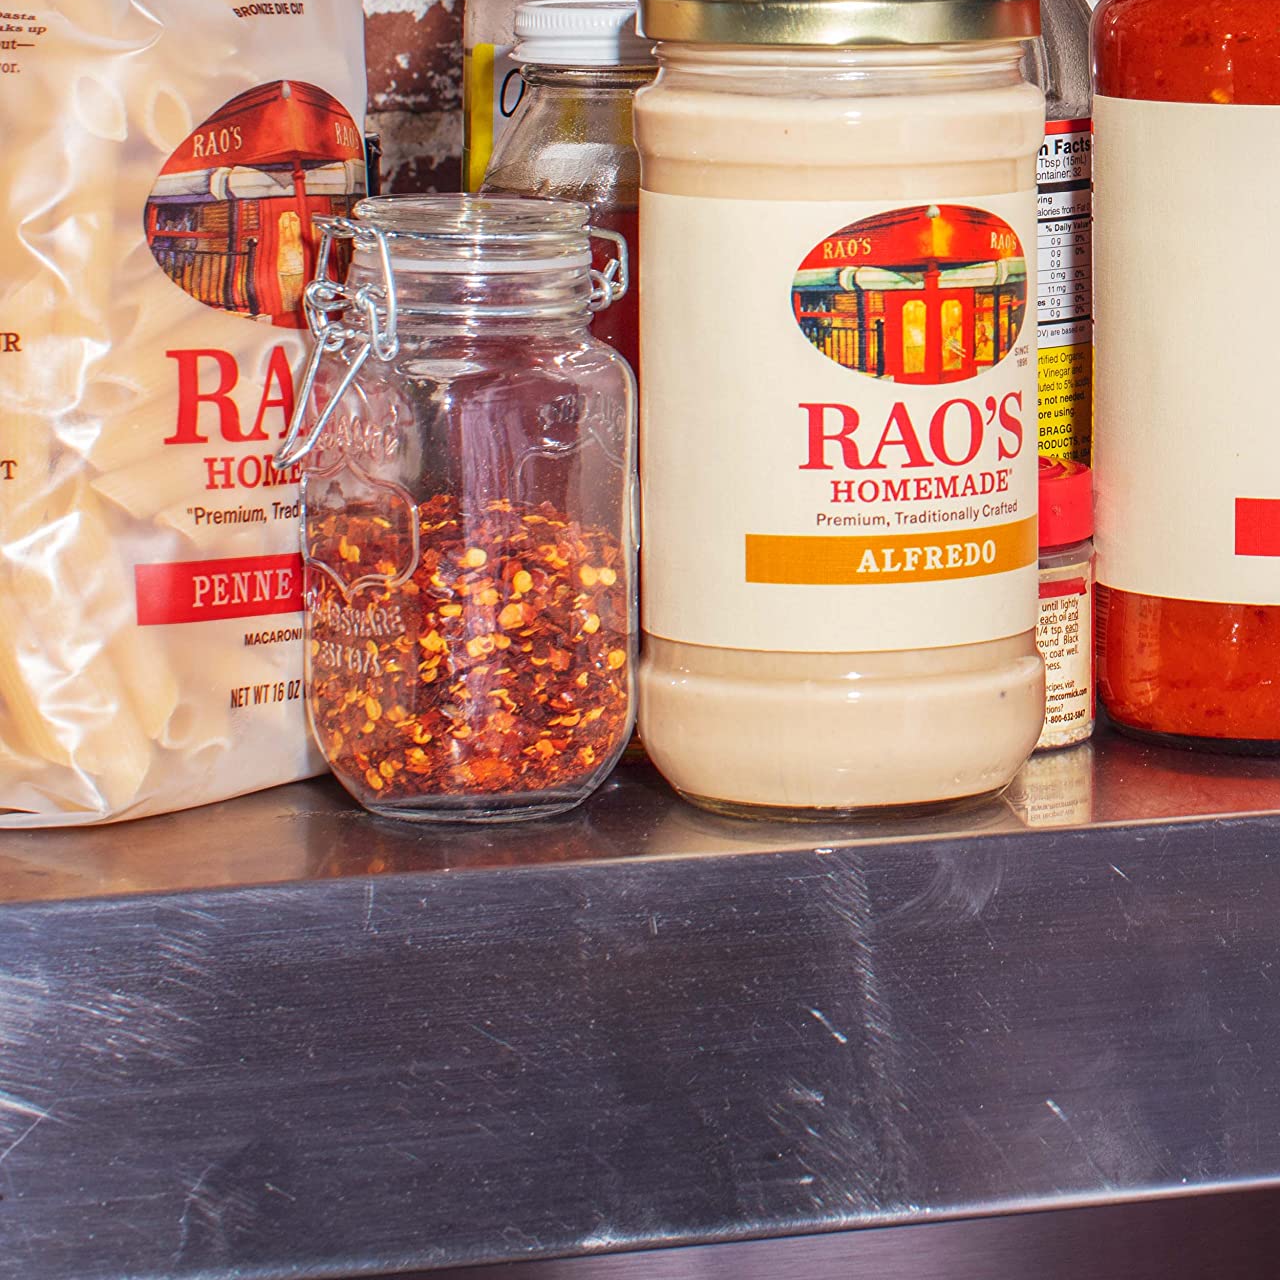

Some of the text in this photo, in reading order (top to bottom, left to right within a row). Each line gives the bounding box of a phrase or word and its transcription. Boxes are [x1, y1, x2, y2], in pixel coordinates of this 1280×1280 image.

[232, 3, 275, 18] BRONZE
[275, 2, 290, 15] DIE
[28, 26, 47, 36] up
[192, 126, 243, 158] RAO'S
[1054, 137, 1090, 154] Facts
[1039, 158, 1061, 169] Tbsp
[1036, 167, 1081, 181] ontainer: 32
[1061, 205, 1075, 215] from
[1054, 222, 1072, 233] Daily
[989, 230, 1018, 252] RAO'S
[822, 236, 873, 261] RAO'S
[1043, 367, 1071, 379] Vinegar
[1044, 395, 1058, 405] not
[798, 390, 1024, 471] RAO'S
[1039, 423, 1073, 437] BRAGG
[816, 500, 1018, 529] Premium, Traditionally Crafted
[856, 540, 997, 574] ALFREDO
[192, 567, 294, 609] PENNE
[1041, 600, 1059, 612] until
[1040, 613, 1058, 625] each
[1065, 622, 1079, 633] each
[244, 628, 303, 646] MACARONI
[1063, 634, 1079, 645] Black
[1049, 649, 1064, 659] coat
[230, 679, 302, 709] NET WT 16 OZ
